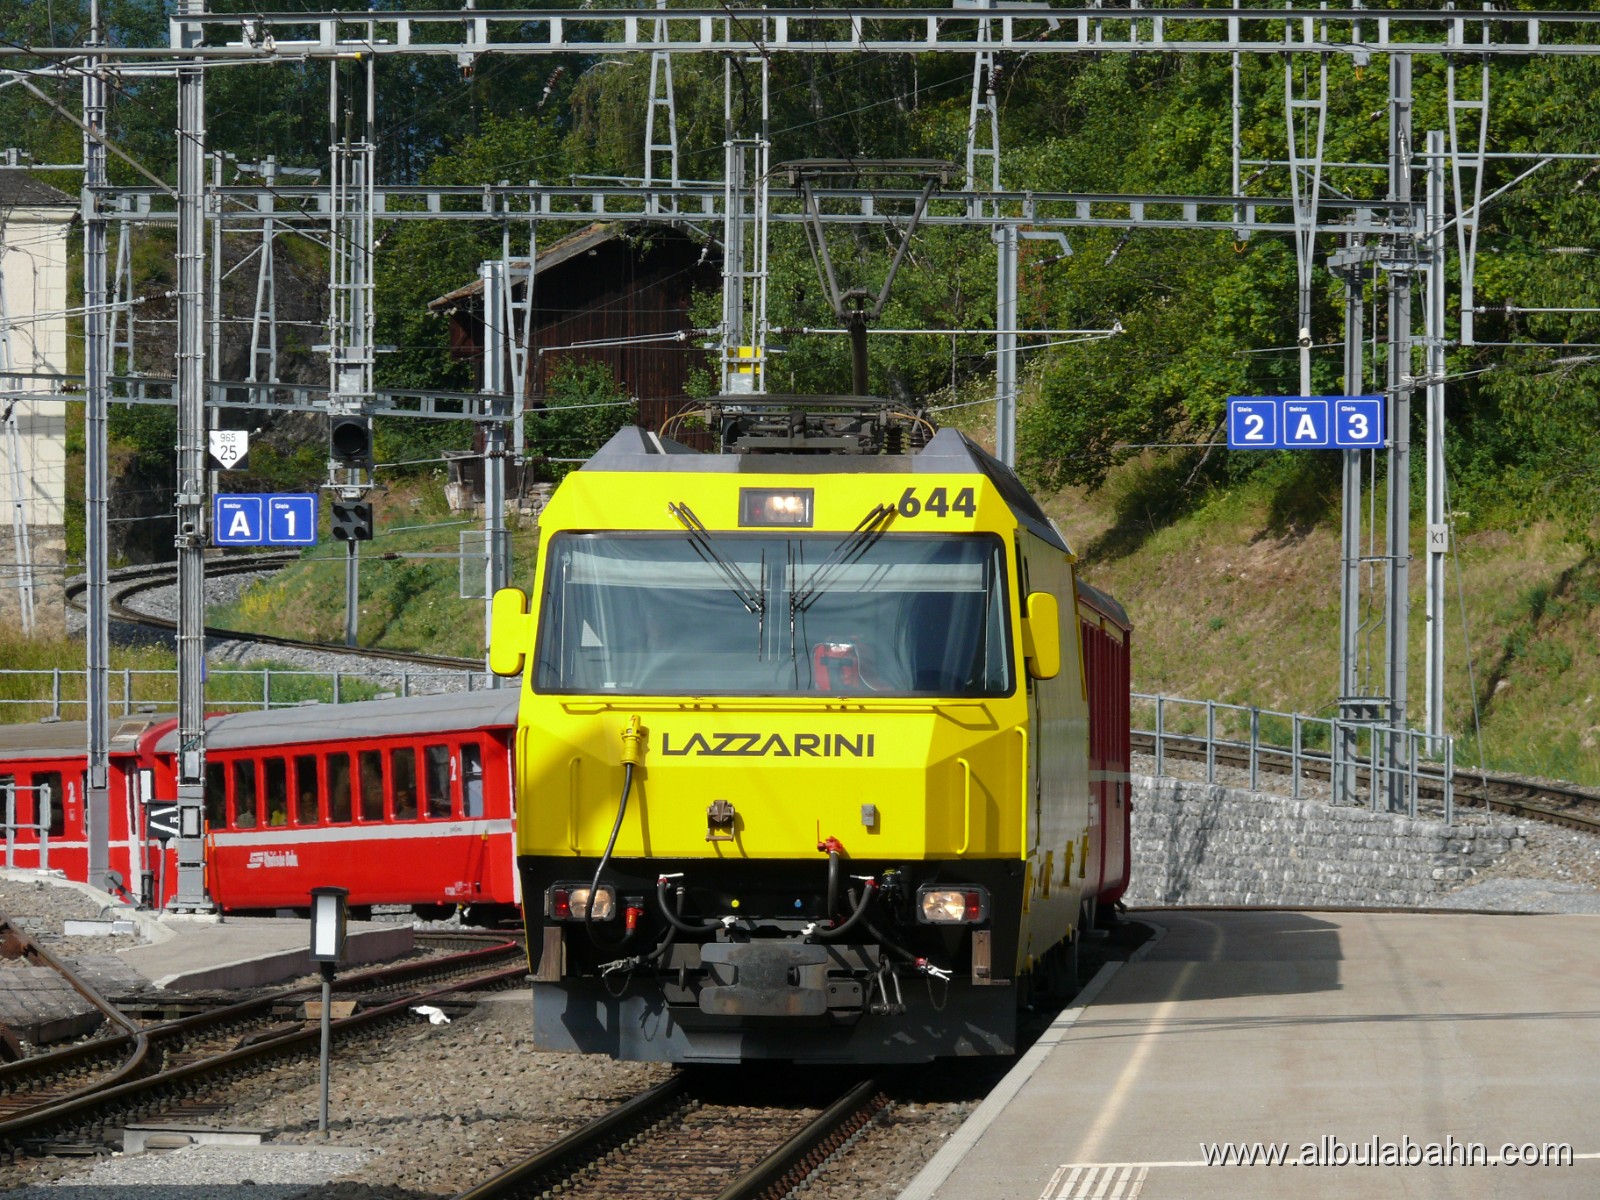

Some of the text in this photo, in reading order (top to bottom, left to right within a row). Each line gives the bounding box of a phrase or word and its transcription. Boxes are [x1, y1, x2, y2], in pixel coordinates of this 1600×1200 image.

[220, 433, 236, 443] 965
[1244, 415, 1264, 440] 2
[1295, 414, 1318, 439] A
[1348, 414, 1369, 439] 3
[220, 445, 238, 461] 25
[898, 487, 977, 518] 644
[228, 511, 251, 537] A
[284, 511, 296, 536] 1
[1431, 531, 1444, 544] K1
[662, 732, 875, 757] LAZZARINI
[68, 782, 76, 803] 2
